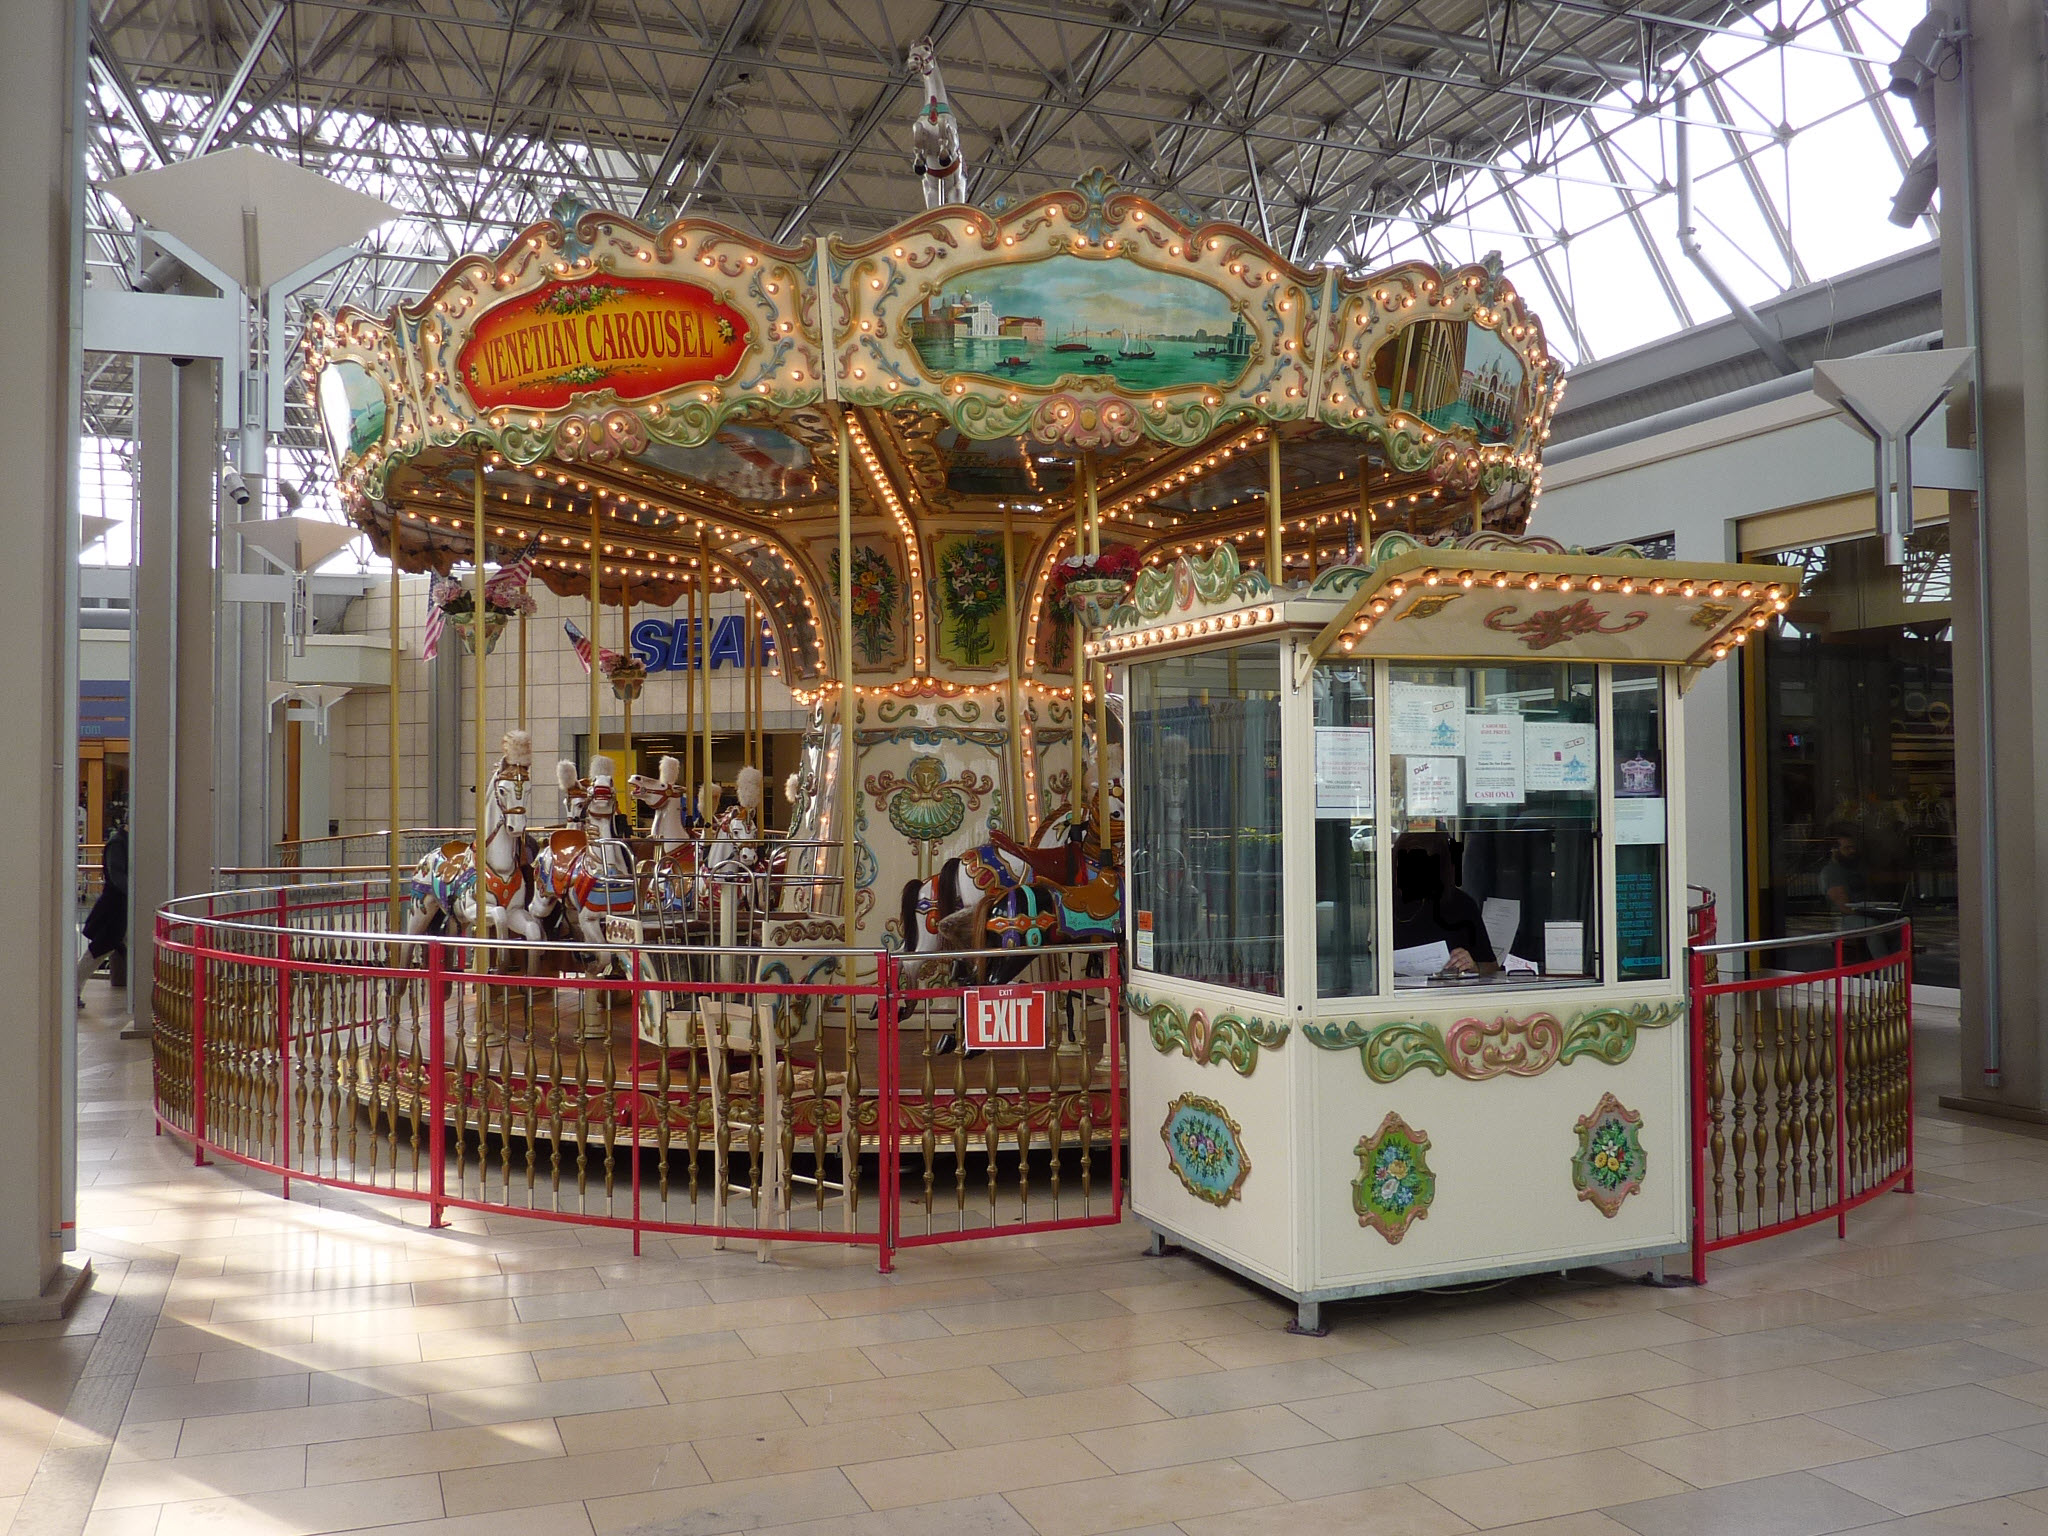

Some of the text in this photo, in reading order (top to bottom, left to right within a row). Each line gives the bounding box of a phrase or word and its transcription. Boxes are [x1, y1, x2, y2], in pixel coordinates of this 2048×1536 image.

[482, 310, 714, 386] VENETIAN CAROUSEL
[1413, 763, 1430, 775] DUE
[1475, 791, 1515, 799] CASH ONLY
[998, 989, 1013, 997] EXIT
[979, 998, 1032, 1042] EXIT
